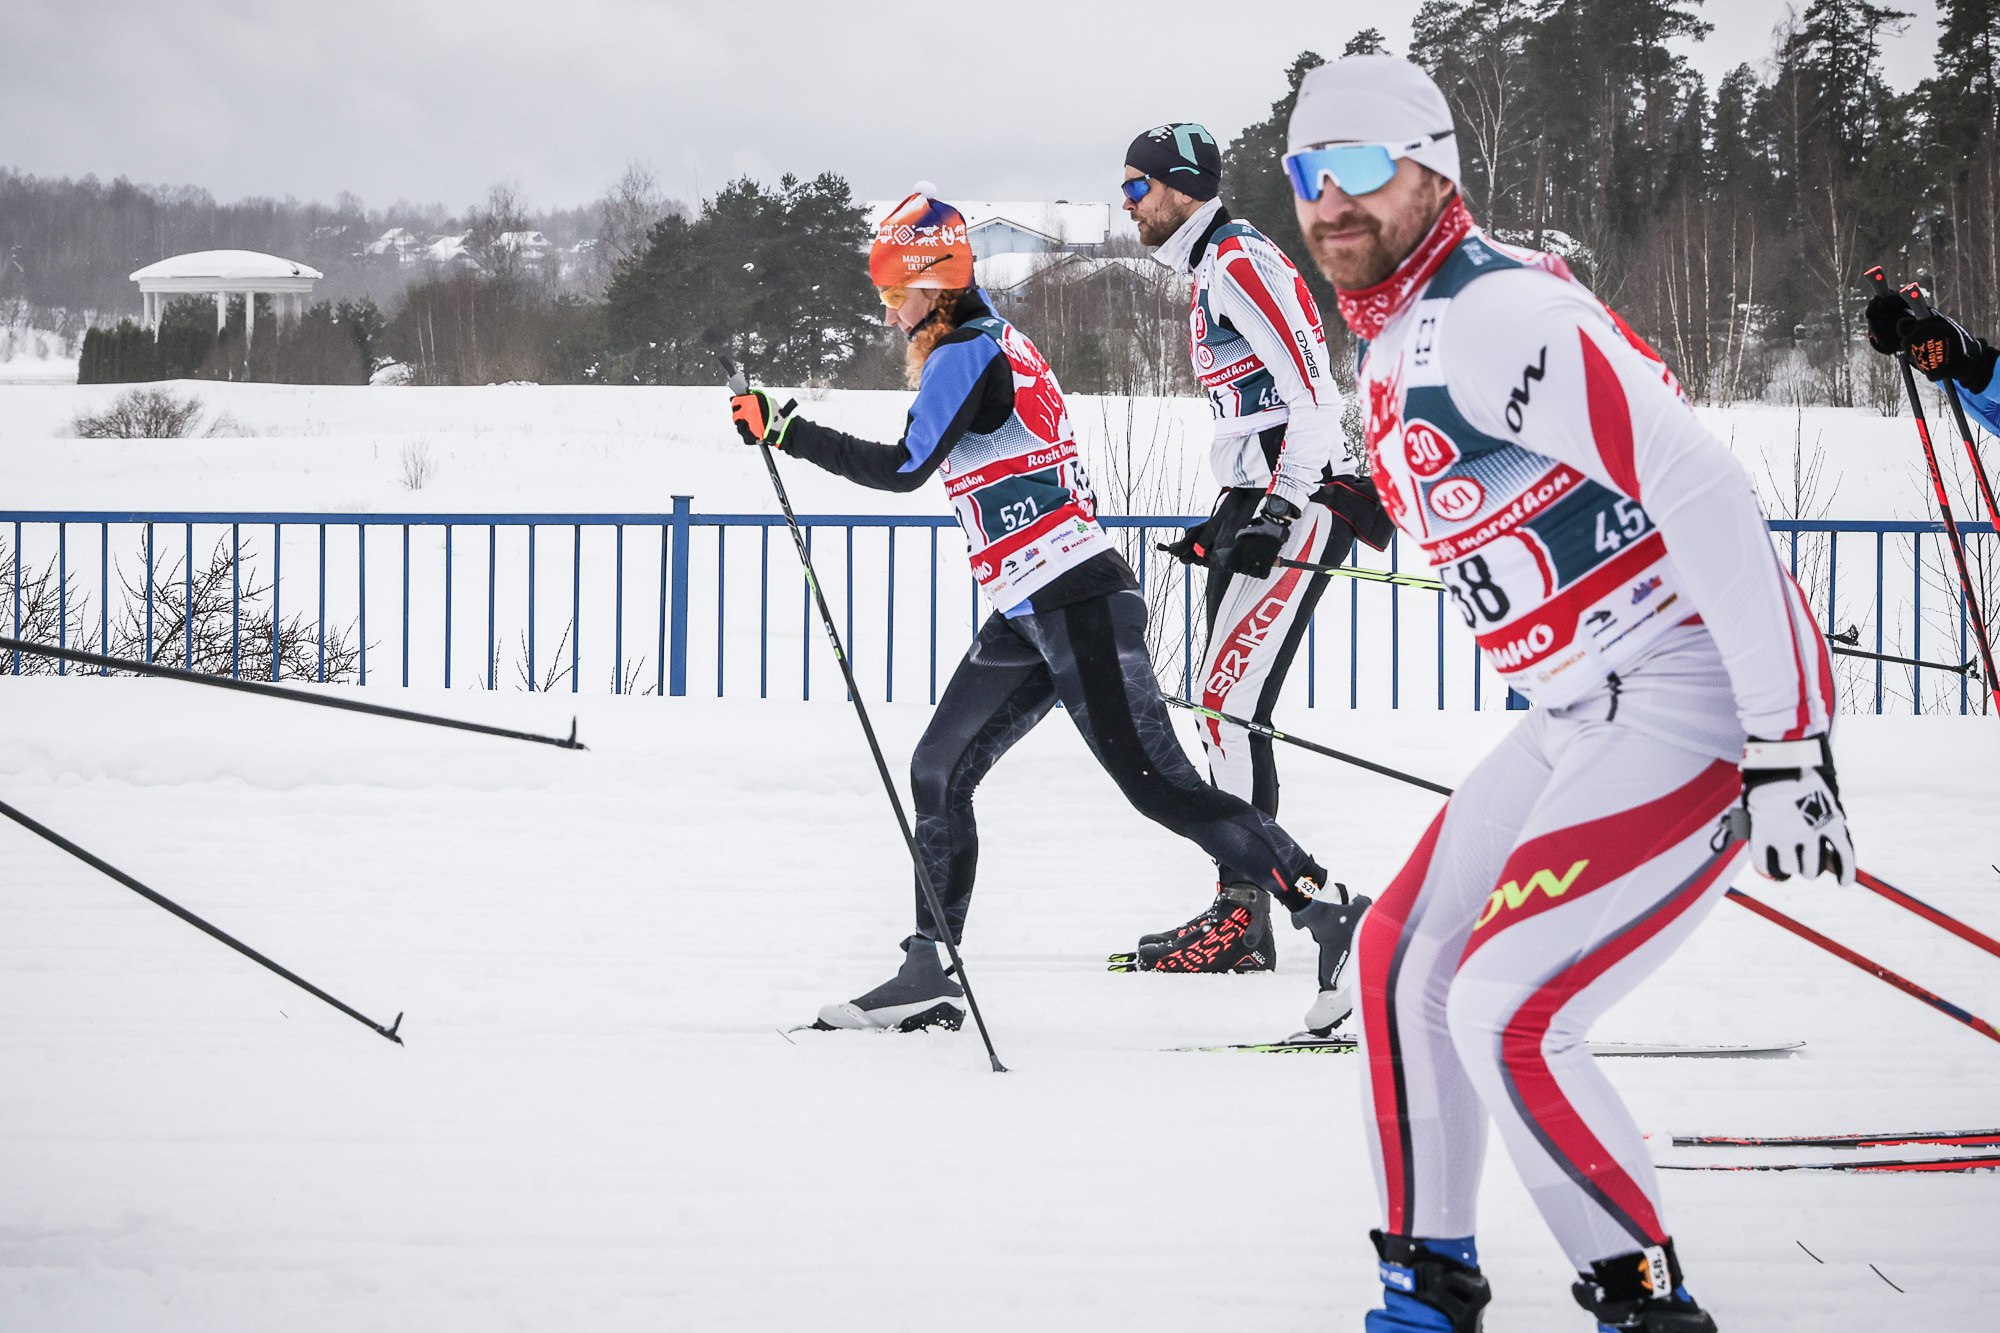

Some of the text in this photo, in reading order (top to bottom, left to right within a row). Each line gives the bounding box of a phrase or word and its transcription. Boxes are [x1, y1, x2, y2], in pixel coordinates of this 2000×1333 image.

[902, 255, 920, 263] MAD
[1407, 430, 1443, 465] 30
[1000, 496, 1038, 531] 521
[1457, 472, 1571, 551] marathon
[1594, 498, 1646, 554] 45
[1205, 597, 1288, 698] BRIKO
[1301, 880, 1316, 895] 521
